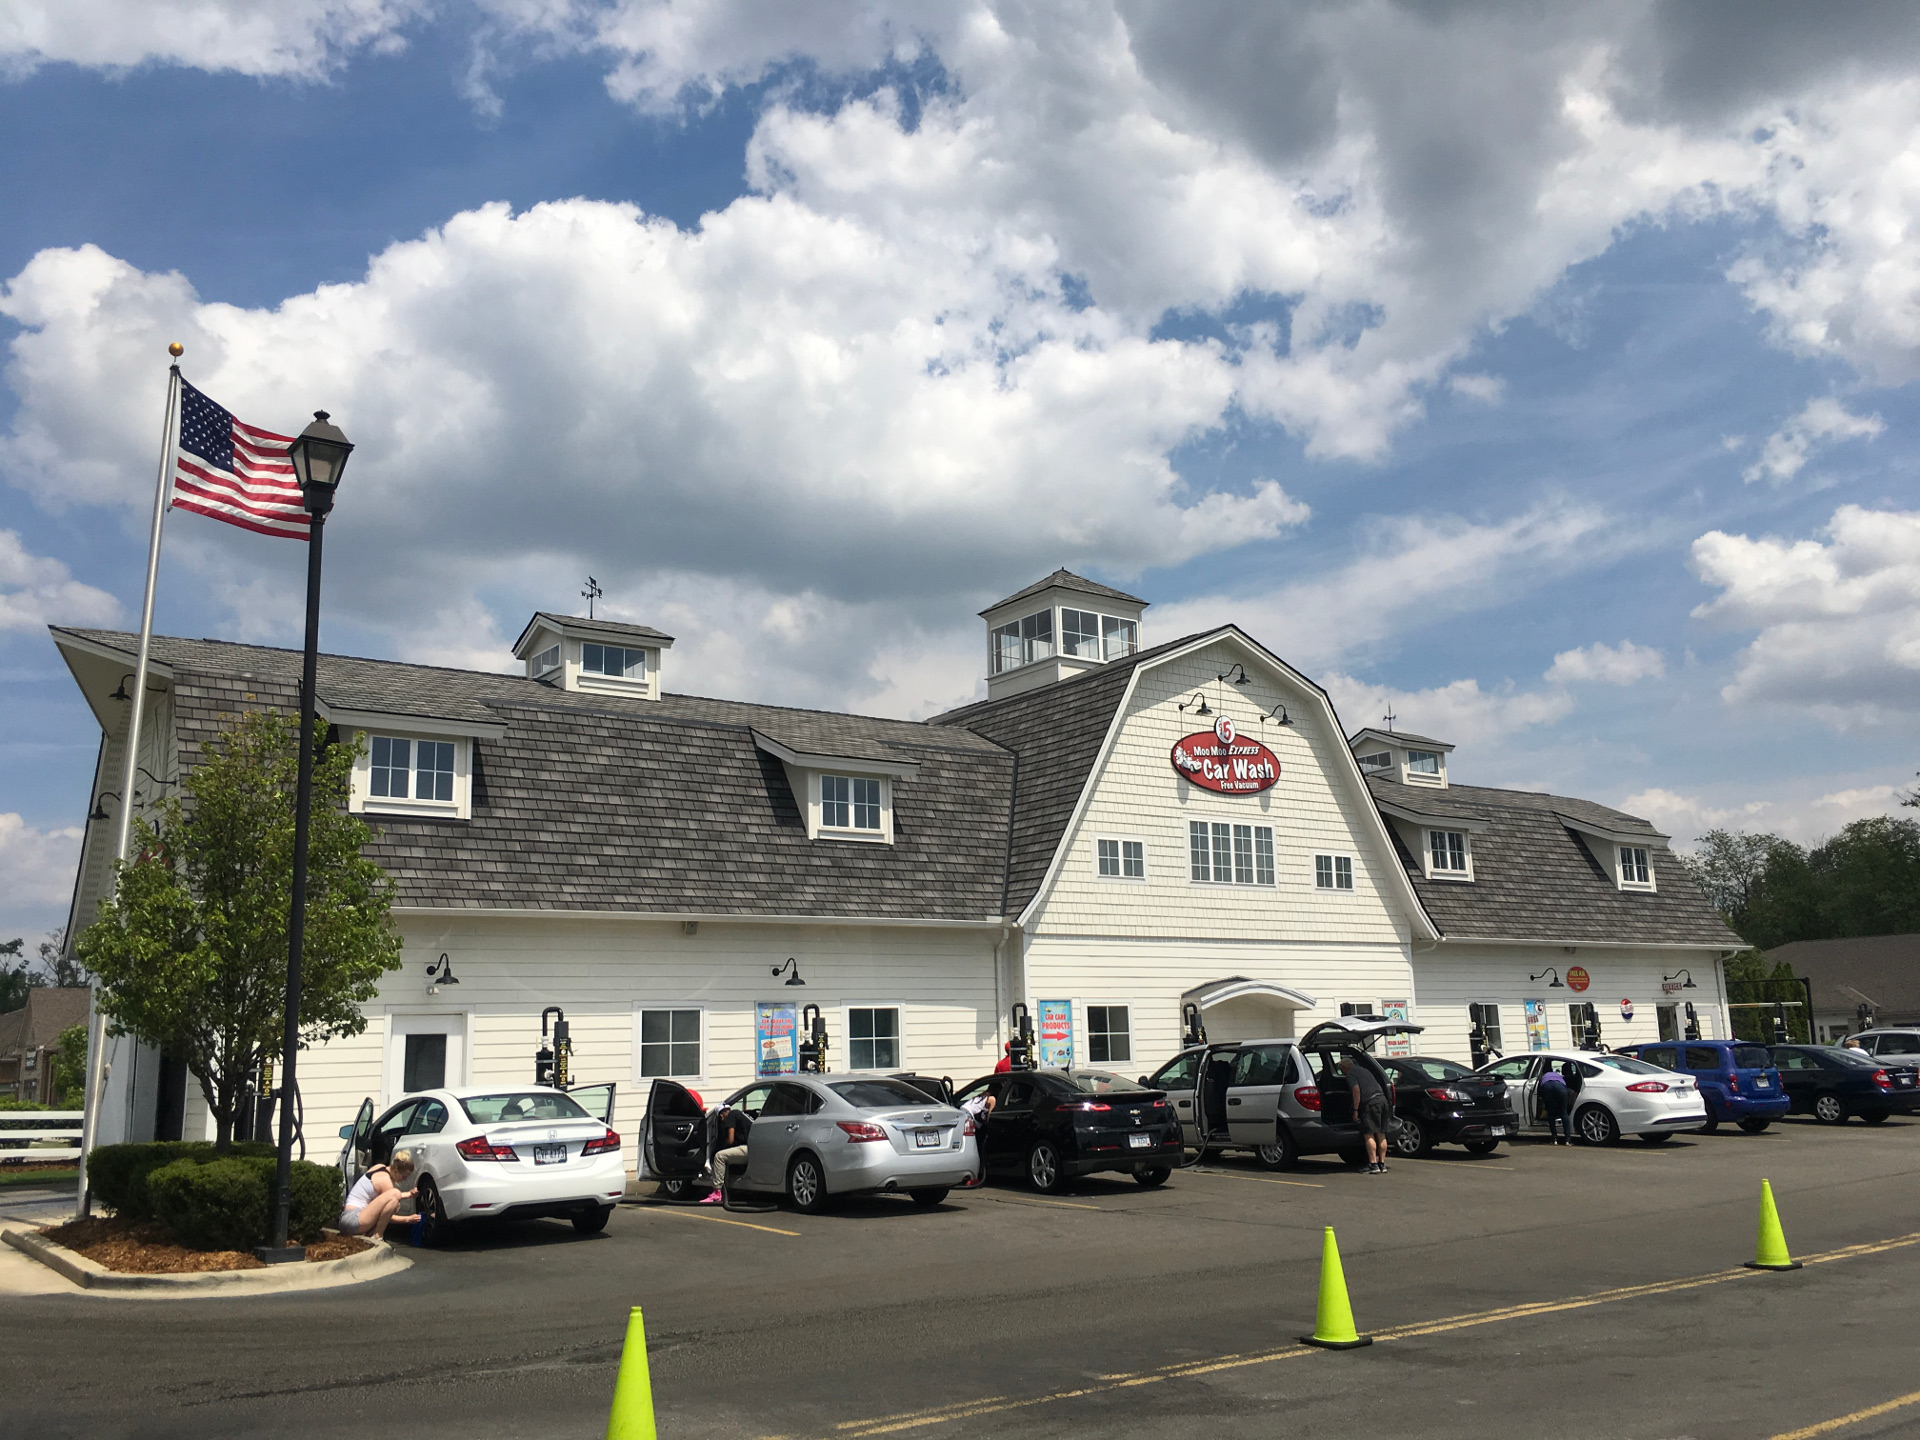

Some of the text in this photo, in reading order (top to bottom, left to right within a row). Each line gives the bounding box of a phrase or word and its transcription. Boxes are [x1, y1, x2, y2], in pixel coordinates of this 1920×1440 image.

[1203, 757, 1275, 780] Car Wash
[1220, 781, 1259, 789] Free Vacuum
[1527, 1015, 1539, 1024] FREE
[1041, 1022, 1070, 1030] PRODUCTS
